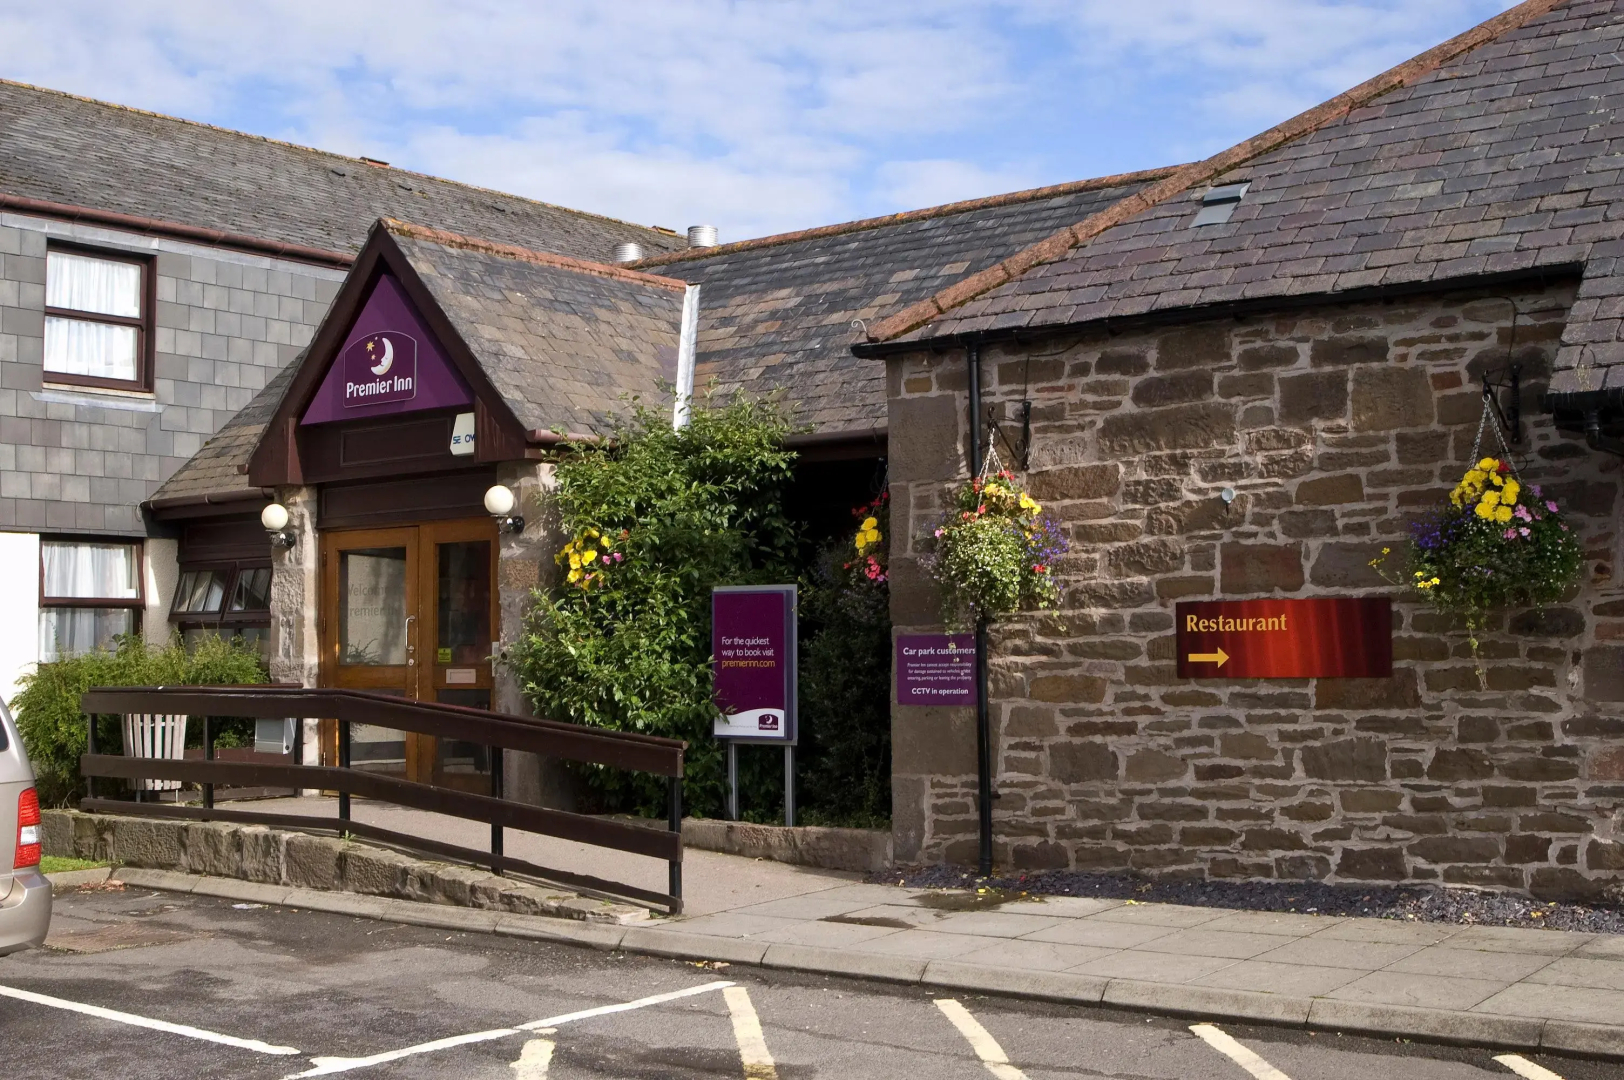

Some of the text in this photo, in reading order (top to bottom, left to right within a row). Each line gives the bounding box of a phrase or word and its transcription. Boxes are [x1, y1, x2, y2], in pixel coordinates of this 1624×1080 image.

[346, 375, 412, 399] Premier Inn
[1186, 613, 1288, 632] Restaurant
[722, 637, 769, 647] For the quickest
[722, 648, 774, 658] way to book visit
[903, 647, 976, 657] Car park customers
[721, 658, 775, 669] premierinn.com
[939, 688, 968, 696] operation
